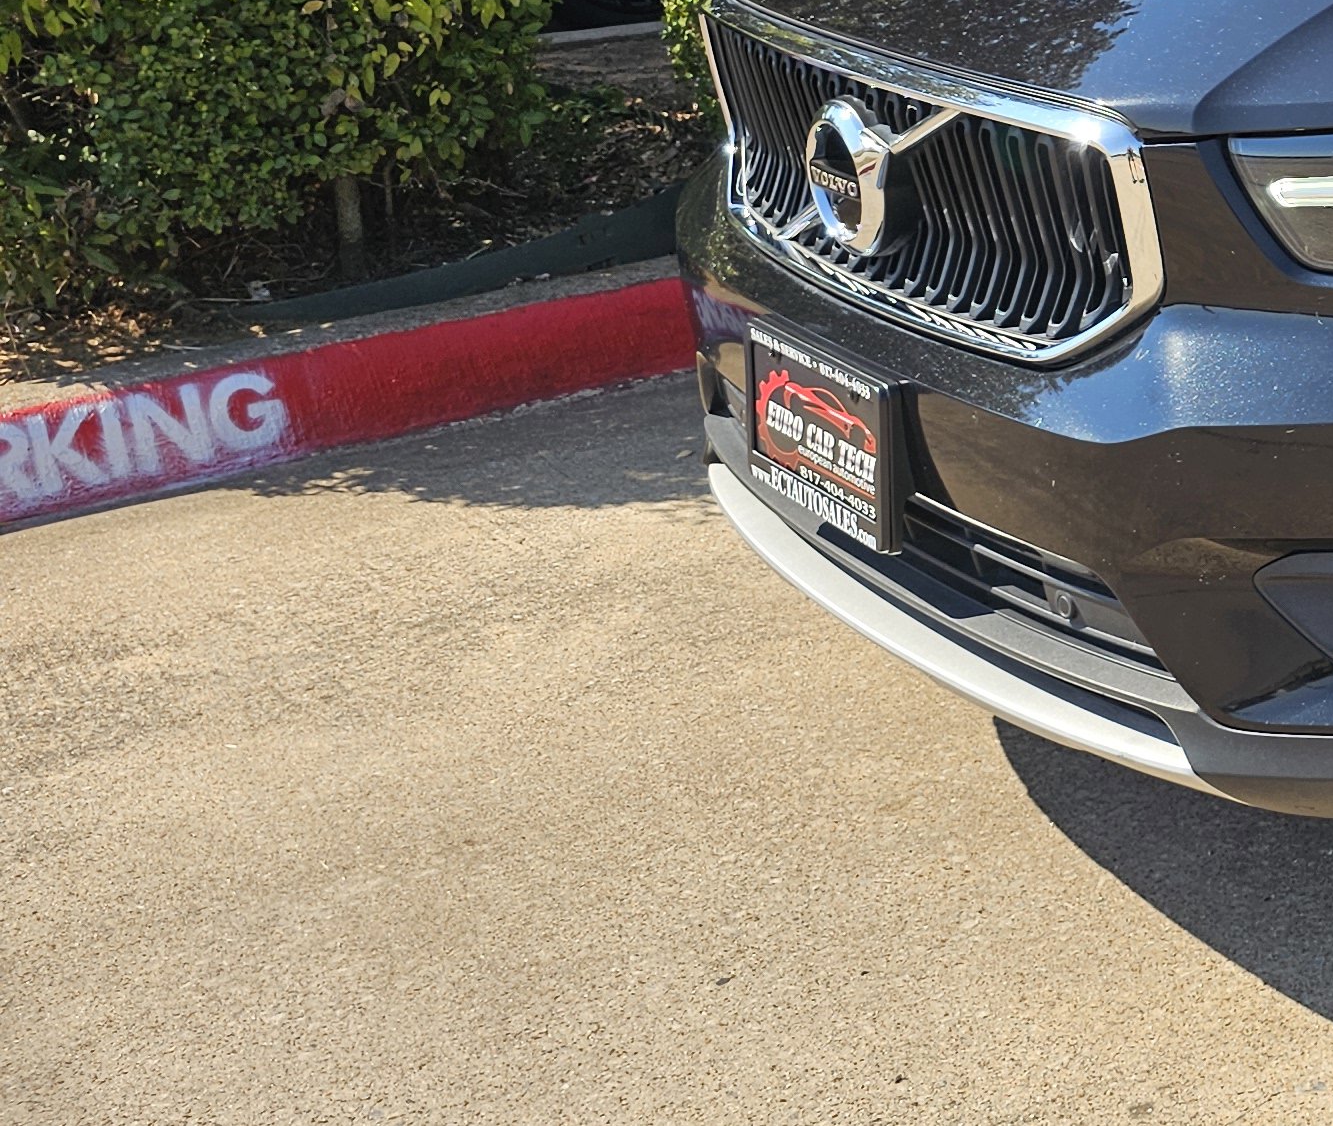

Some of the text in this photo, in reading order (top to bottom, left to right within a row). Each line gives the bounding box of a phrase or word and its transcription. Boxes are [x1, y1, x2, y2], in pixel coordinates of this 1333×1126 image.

[811, 165, 859, 198] VOLVO
[766, 400, 876, 483] EURO CAR TECH
[798, 445, 876, 495] european automotive
[800, 465, 876, 519] 817-404-4033
[750, 464, 877, 550] www.ECTAUTOSALES.com
